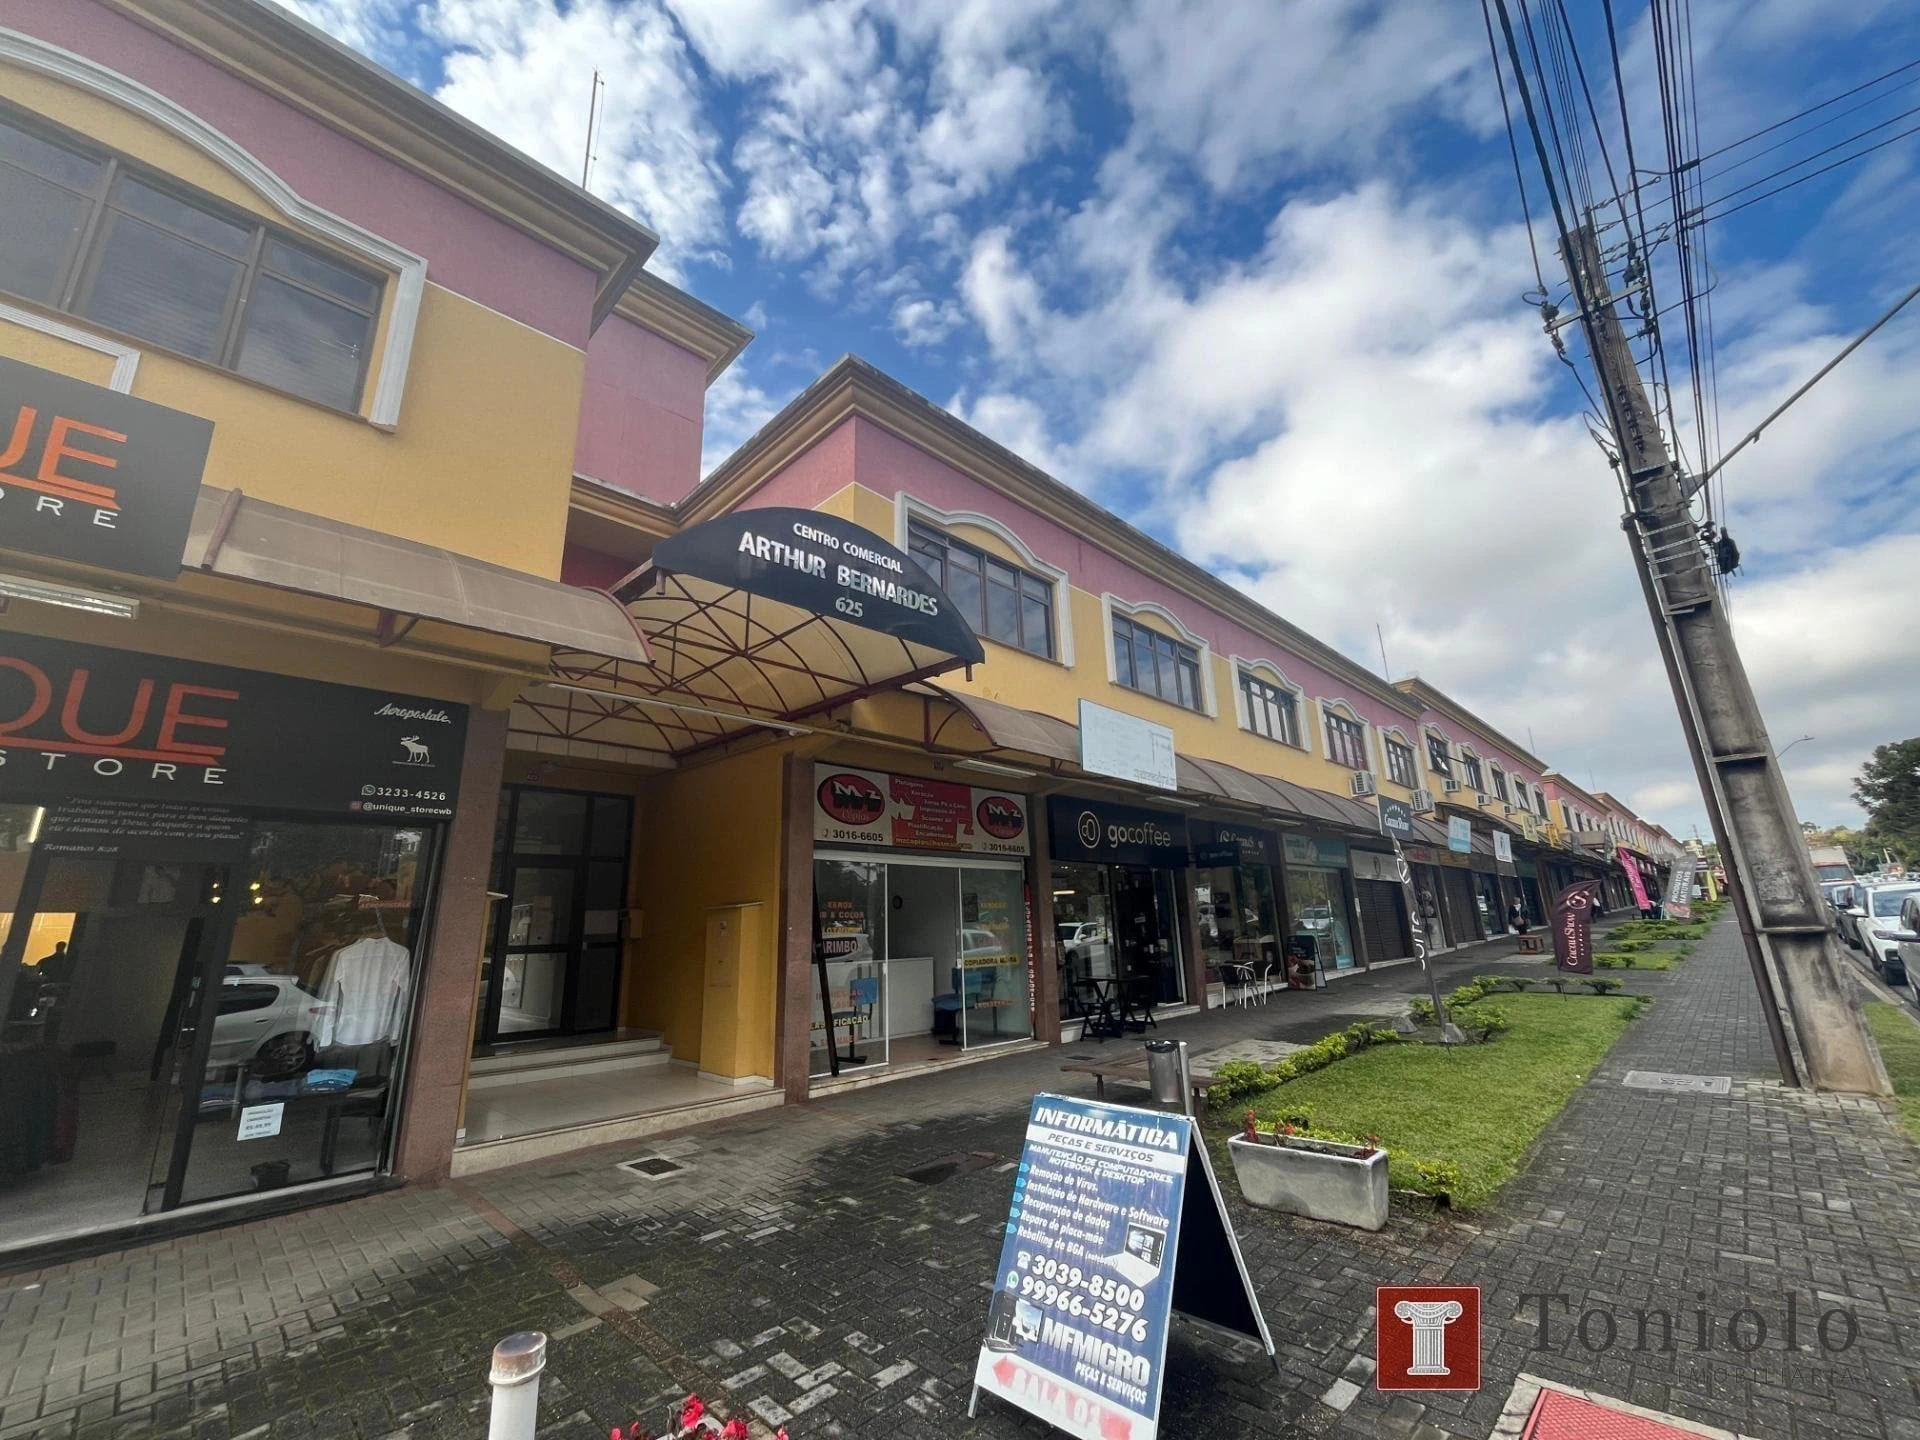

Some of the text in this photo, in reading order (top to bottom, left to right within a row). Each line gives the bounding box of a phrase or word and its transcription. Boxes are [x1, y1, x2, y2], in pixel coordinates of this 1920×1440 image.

[793, 522, 904, 574] CENTRO COMERCIAL
[738, 531, 938, 617] ARTHUR BERNARDES
[835, 596, 863, 618] 625
[363, 802, 452, 815] @unique_storecwb
[377, 787, 447, 801] 3233-4526
[1108, 823, 1172, 849] gocoffee
[1035, 1107, 1178, 1150] INFORMÁTICA
[1028, 1144, 1084, 1163] MANUTENÇÃO
[1085, 1157, 1098, 1166] DE
[1048, 1133, 1155, 1163] PEÇAS E SERVIÇOS
[1030, 1164, 1063, 1182] Remoção
[1064, 1173, 1075, 1185] de
[1048, 1157, 1094, 1173] NOTEBOOK
[1094, 1167, 1102, 1176] E
[1023, 1194, 1111, 1229] Recuperação de dados
[1027, 1179, 1170, 1228] Instalação de Hardware e Software
[1016, 1225, 1054, 1249] Reballing
[1054, 1237, 1066, 1250] de
[1066, 1240, 1085, 1257] BGA
[1020, 1209, 1105, 1246] Reparo de placa-mãe
[1031, 1254, 1145, 1312] 3039-8500
[1019, 1275, 1150, 1342] 99966-5276
[1041, 1317, 1151, 1388] MFMICRO
[1074, 1361, 1148, 1405] PEÇAS E SERVIÇOS
